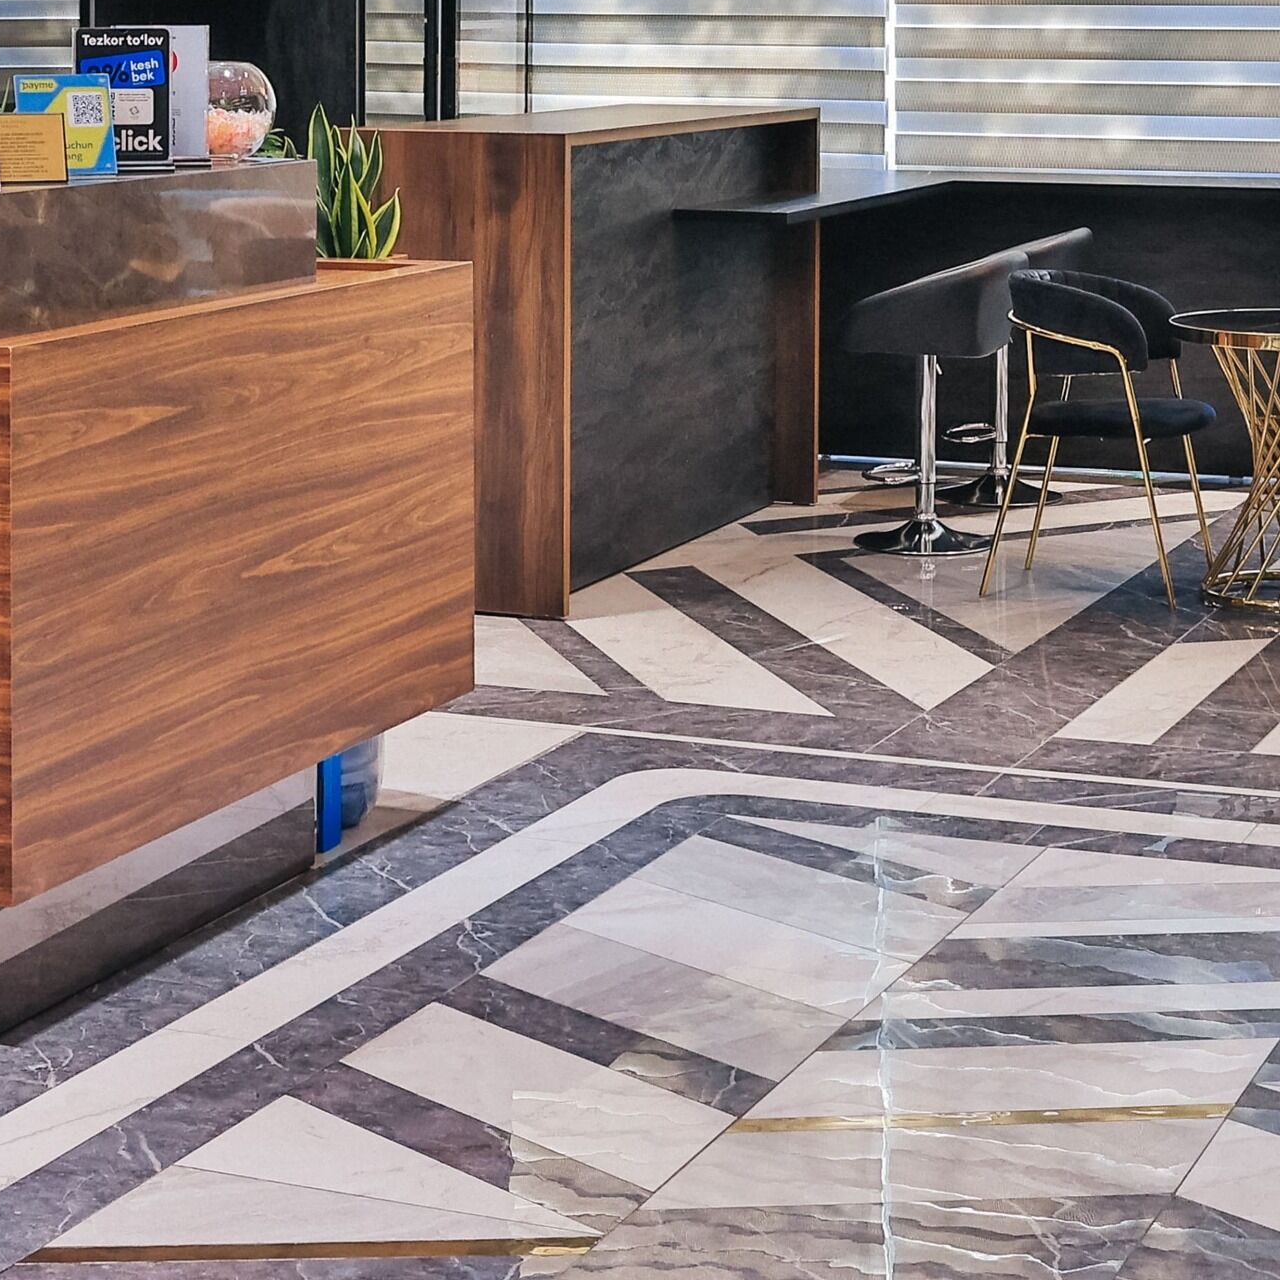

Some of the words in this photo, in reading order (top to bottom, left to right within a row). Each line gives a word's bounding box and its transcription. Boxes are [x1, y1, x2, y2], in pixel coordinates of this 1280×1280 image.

[81, 33, 125, 46] Tezkor
[130, 57, 159, 71] kesh
[131, 69, 155, 82] bek
[22, 81, 54, 91] payme
[66, 141, 94, 150] uchun
